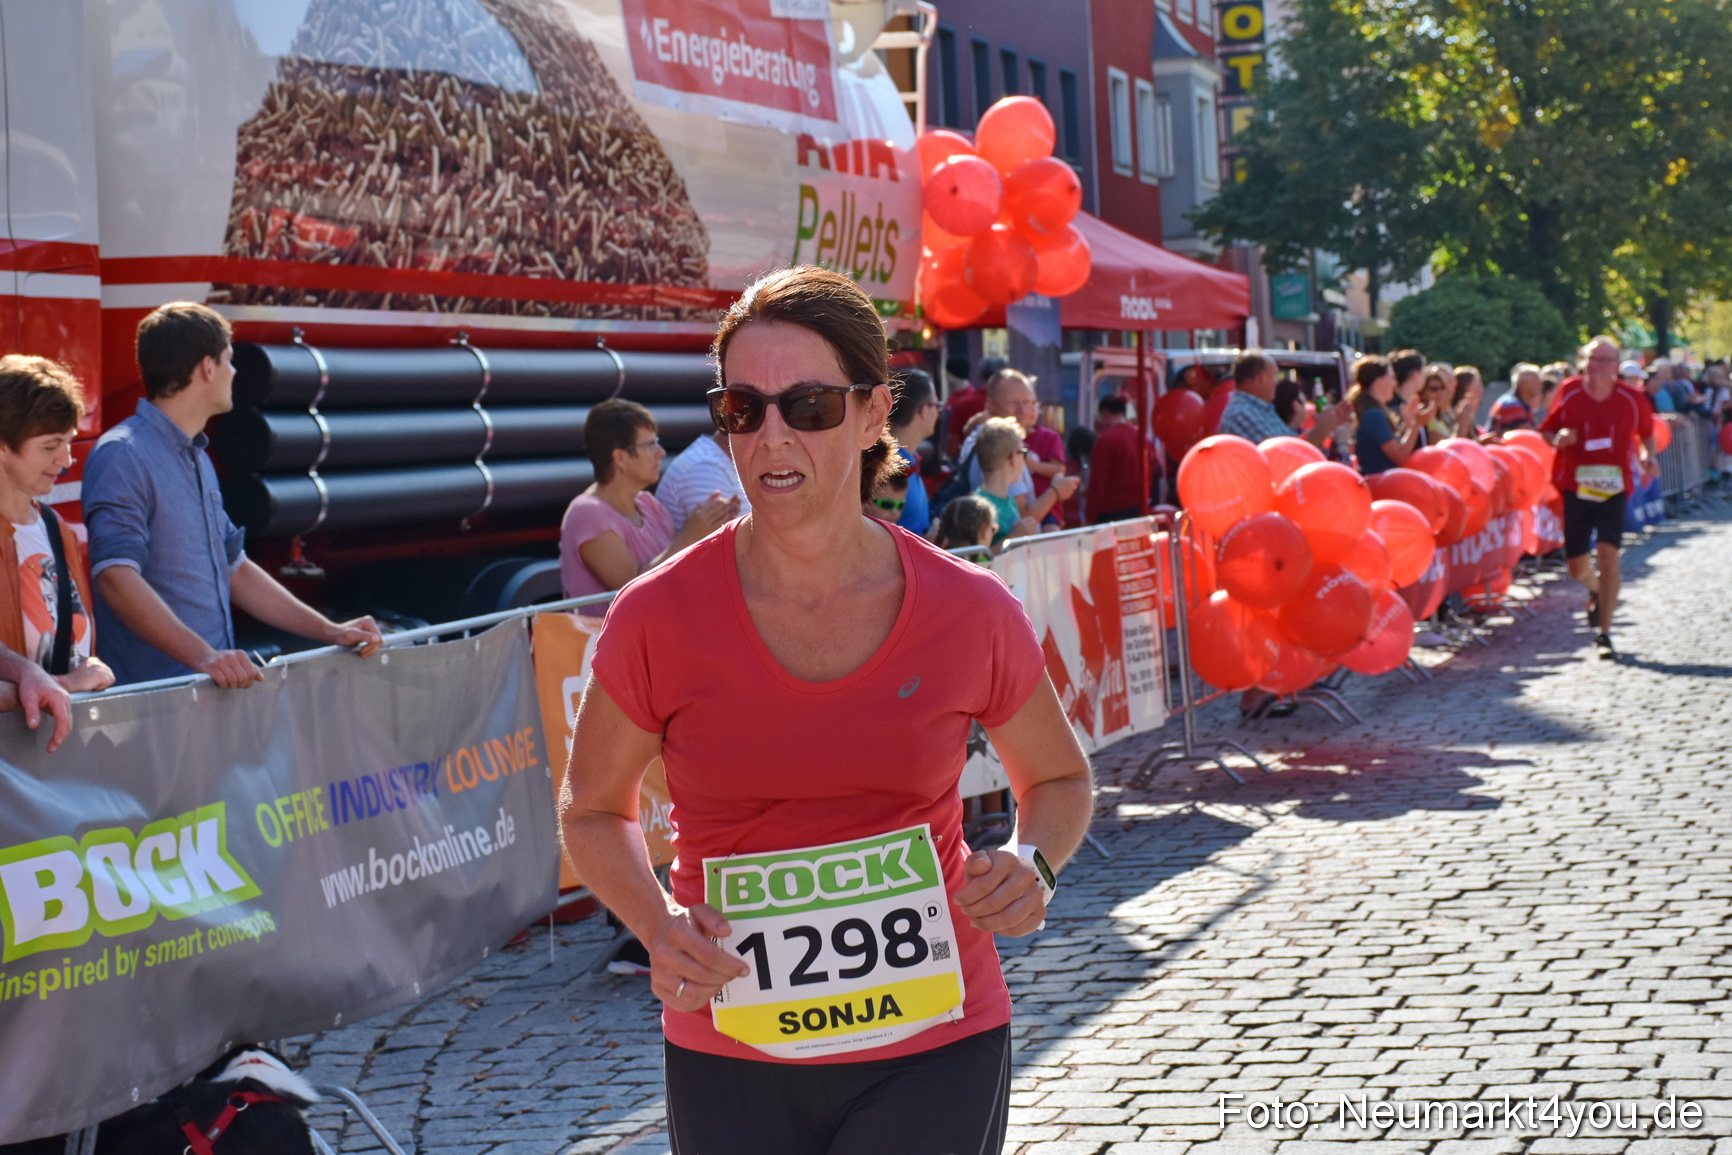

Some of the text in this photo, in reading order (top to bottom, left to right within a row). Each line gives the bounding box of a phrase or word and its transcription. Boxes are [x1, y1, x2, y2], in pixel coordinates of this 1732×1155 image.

[652, 17, 818, 108] Energieberatung
[791, 183, 900, 285] Pellets
[256, 727, 539, 848] OFFICE INDUSTRY LOUNGE
[1, 816, 247, 946] BOCK
[320, 806, 517, 909] www.bockonline.de
[725, 844, 914, 907] BOCK
[0, 909, 276, 1000] inspired by smart concepts
[735, 907, 929, 991] 1298
[926, 905, 938, 918] D
[778, 993, 904, 1035] SONJA
